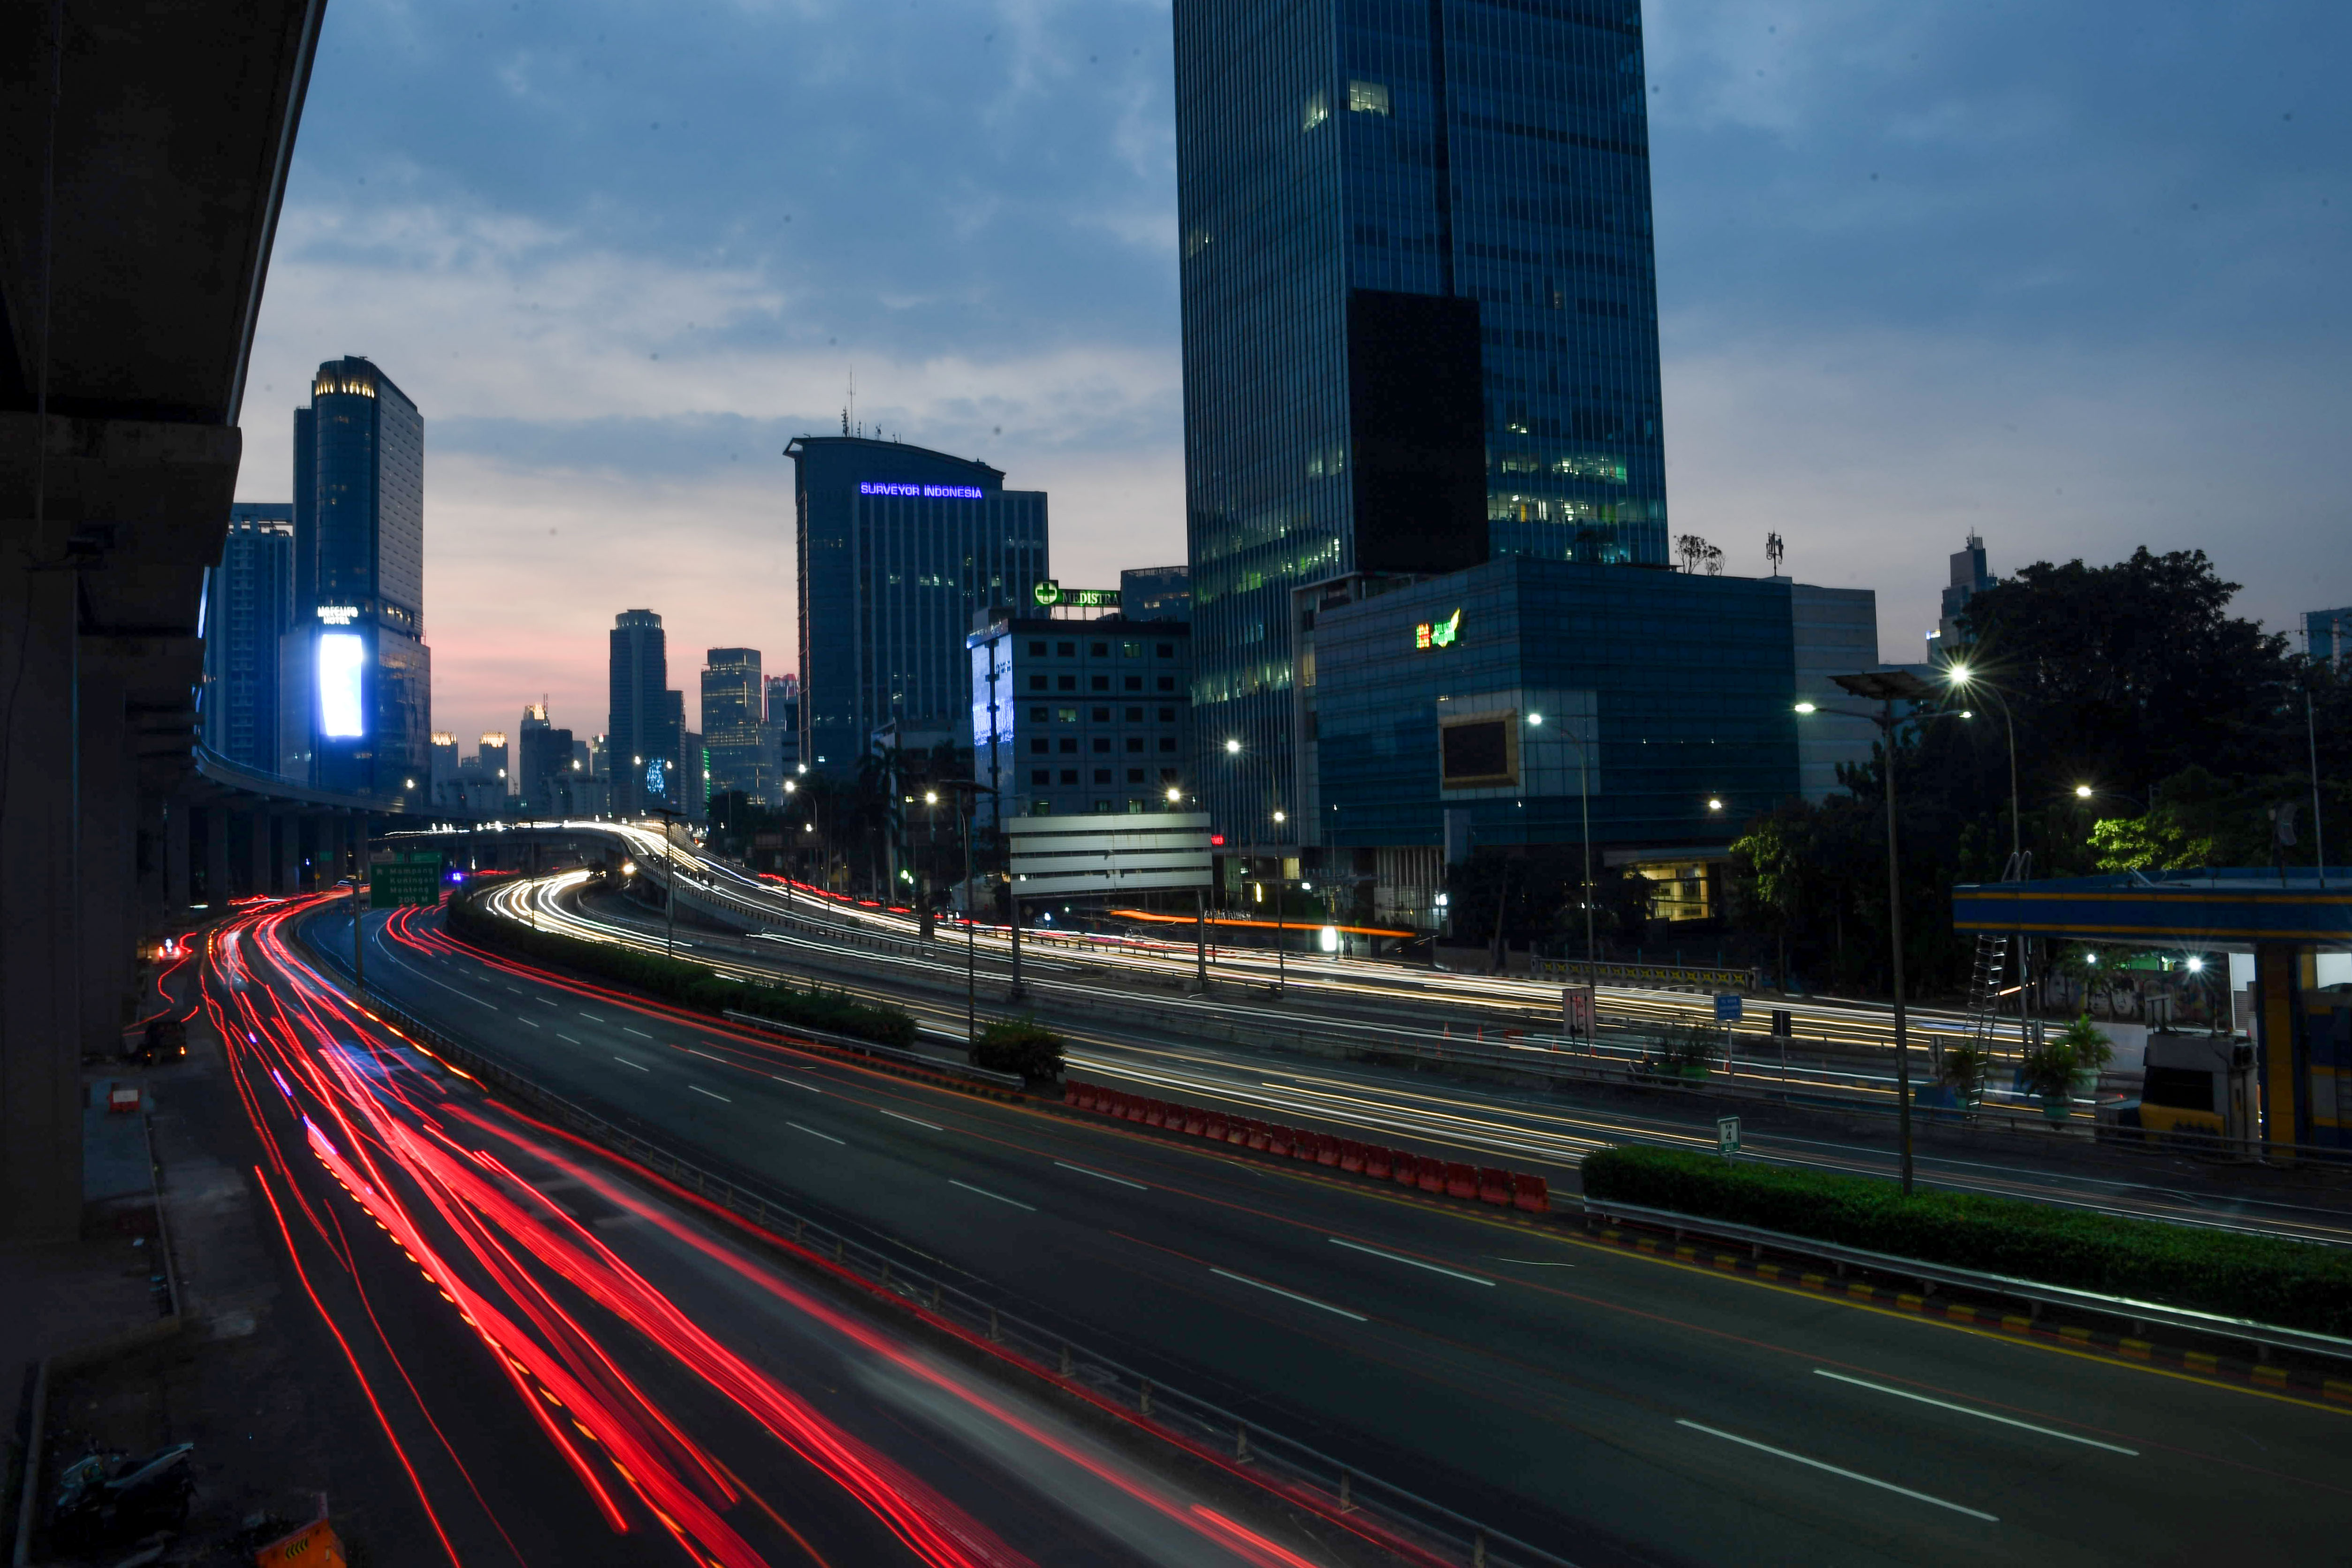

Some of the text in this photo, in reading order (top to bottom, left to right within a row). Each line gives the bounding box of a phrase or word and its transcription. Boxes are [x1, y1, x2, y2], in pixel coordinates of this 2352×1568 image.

[860, 482, 982, 499] SURVEYOR INDONESIA
[1062, 592, 1119, 604] MEDISTRA
[323, 615, 350, 624] HOTEL
[389, 886, 429, 895] Menteng
[1726, 1131, 1731, 1142] 4
